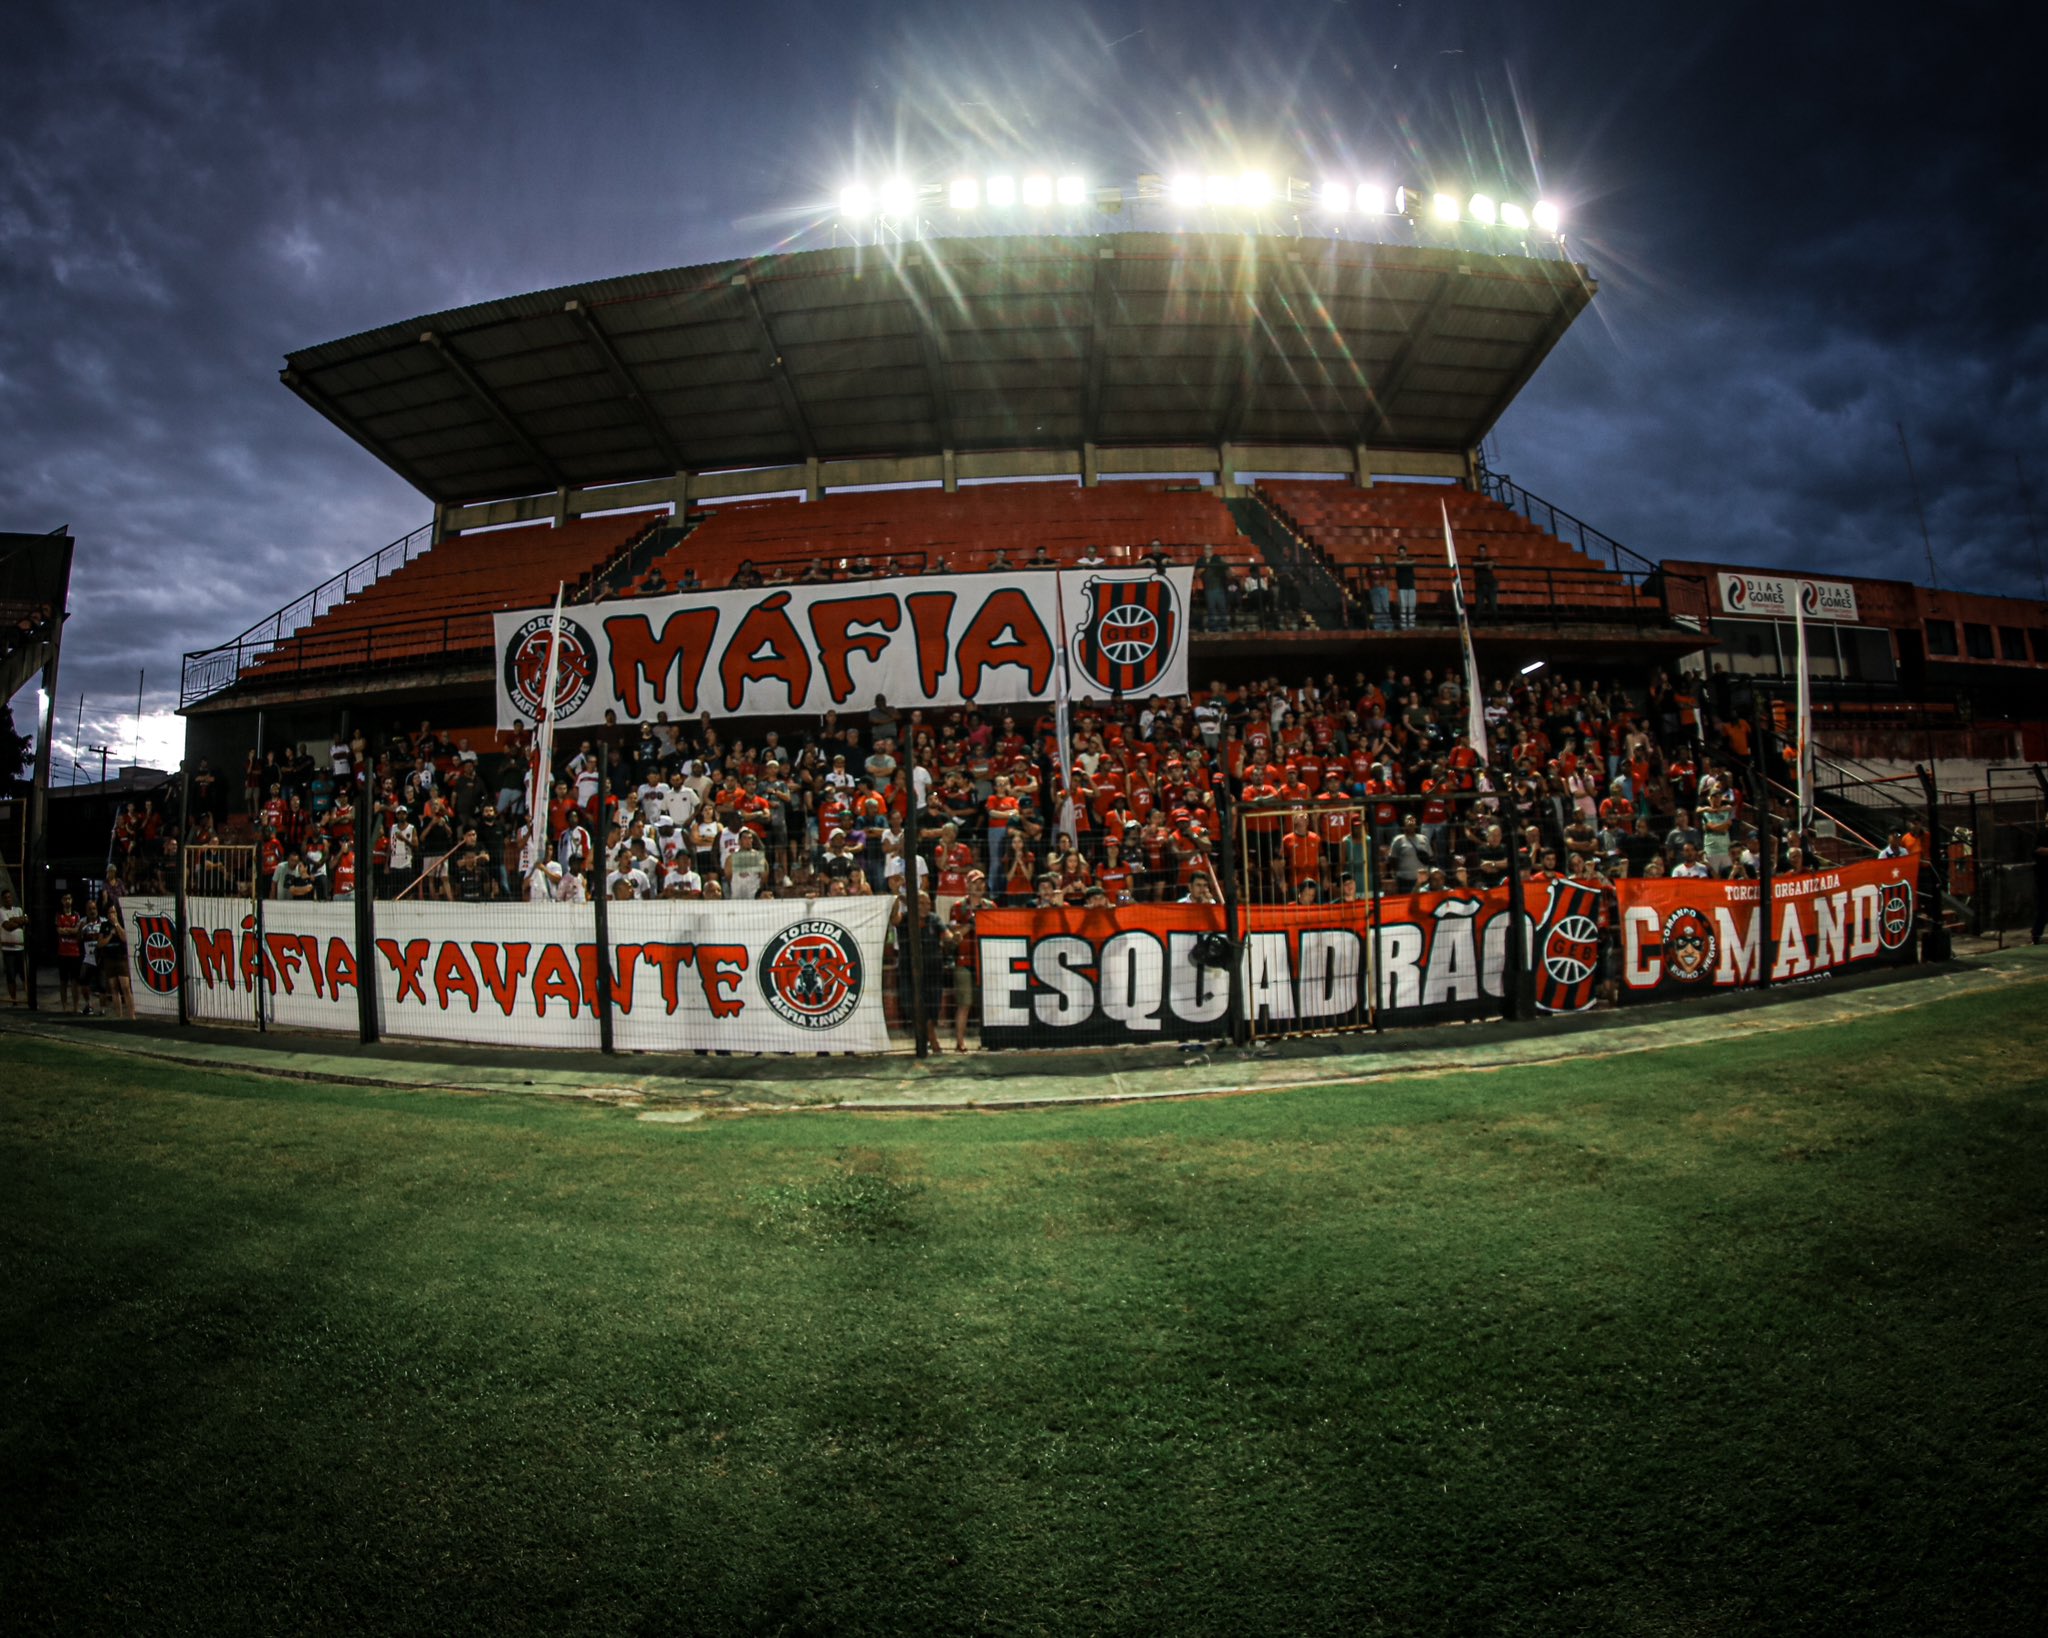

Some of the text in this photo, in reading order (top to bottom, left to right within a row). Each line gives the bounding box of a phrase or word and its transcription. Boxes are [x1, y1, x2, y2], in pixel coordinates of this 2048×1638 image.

[1747, 581, 1783, 593] DIAS
[1818, 586, 1850, 598] DIAS
[1748, 592, 1785, 604] GOMES
[1820, 597, 1852, 608] GOMES
[519, 617, 576, 637] TORCDA
[1107, 626, 1150, 640] GEB
[603, 587, 1055, 718] MÁFIA
[552, 682, 591, 720] AVANTE
[1330, 814, 1345, 827] 21
[1724, 873, 1841, 901] TORCI ORGANIZADA
[779, 922, 843, 942] TORCIDA
[189, 914, 749, 1019] MÁFIA XAVANTE
[770, 991, 858, 1027] MAFIA XAVANTE
